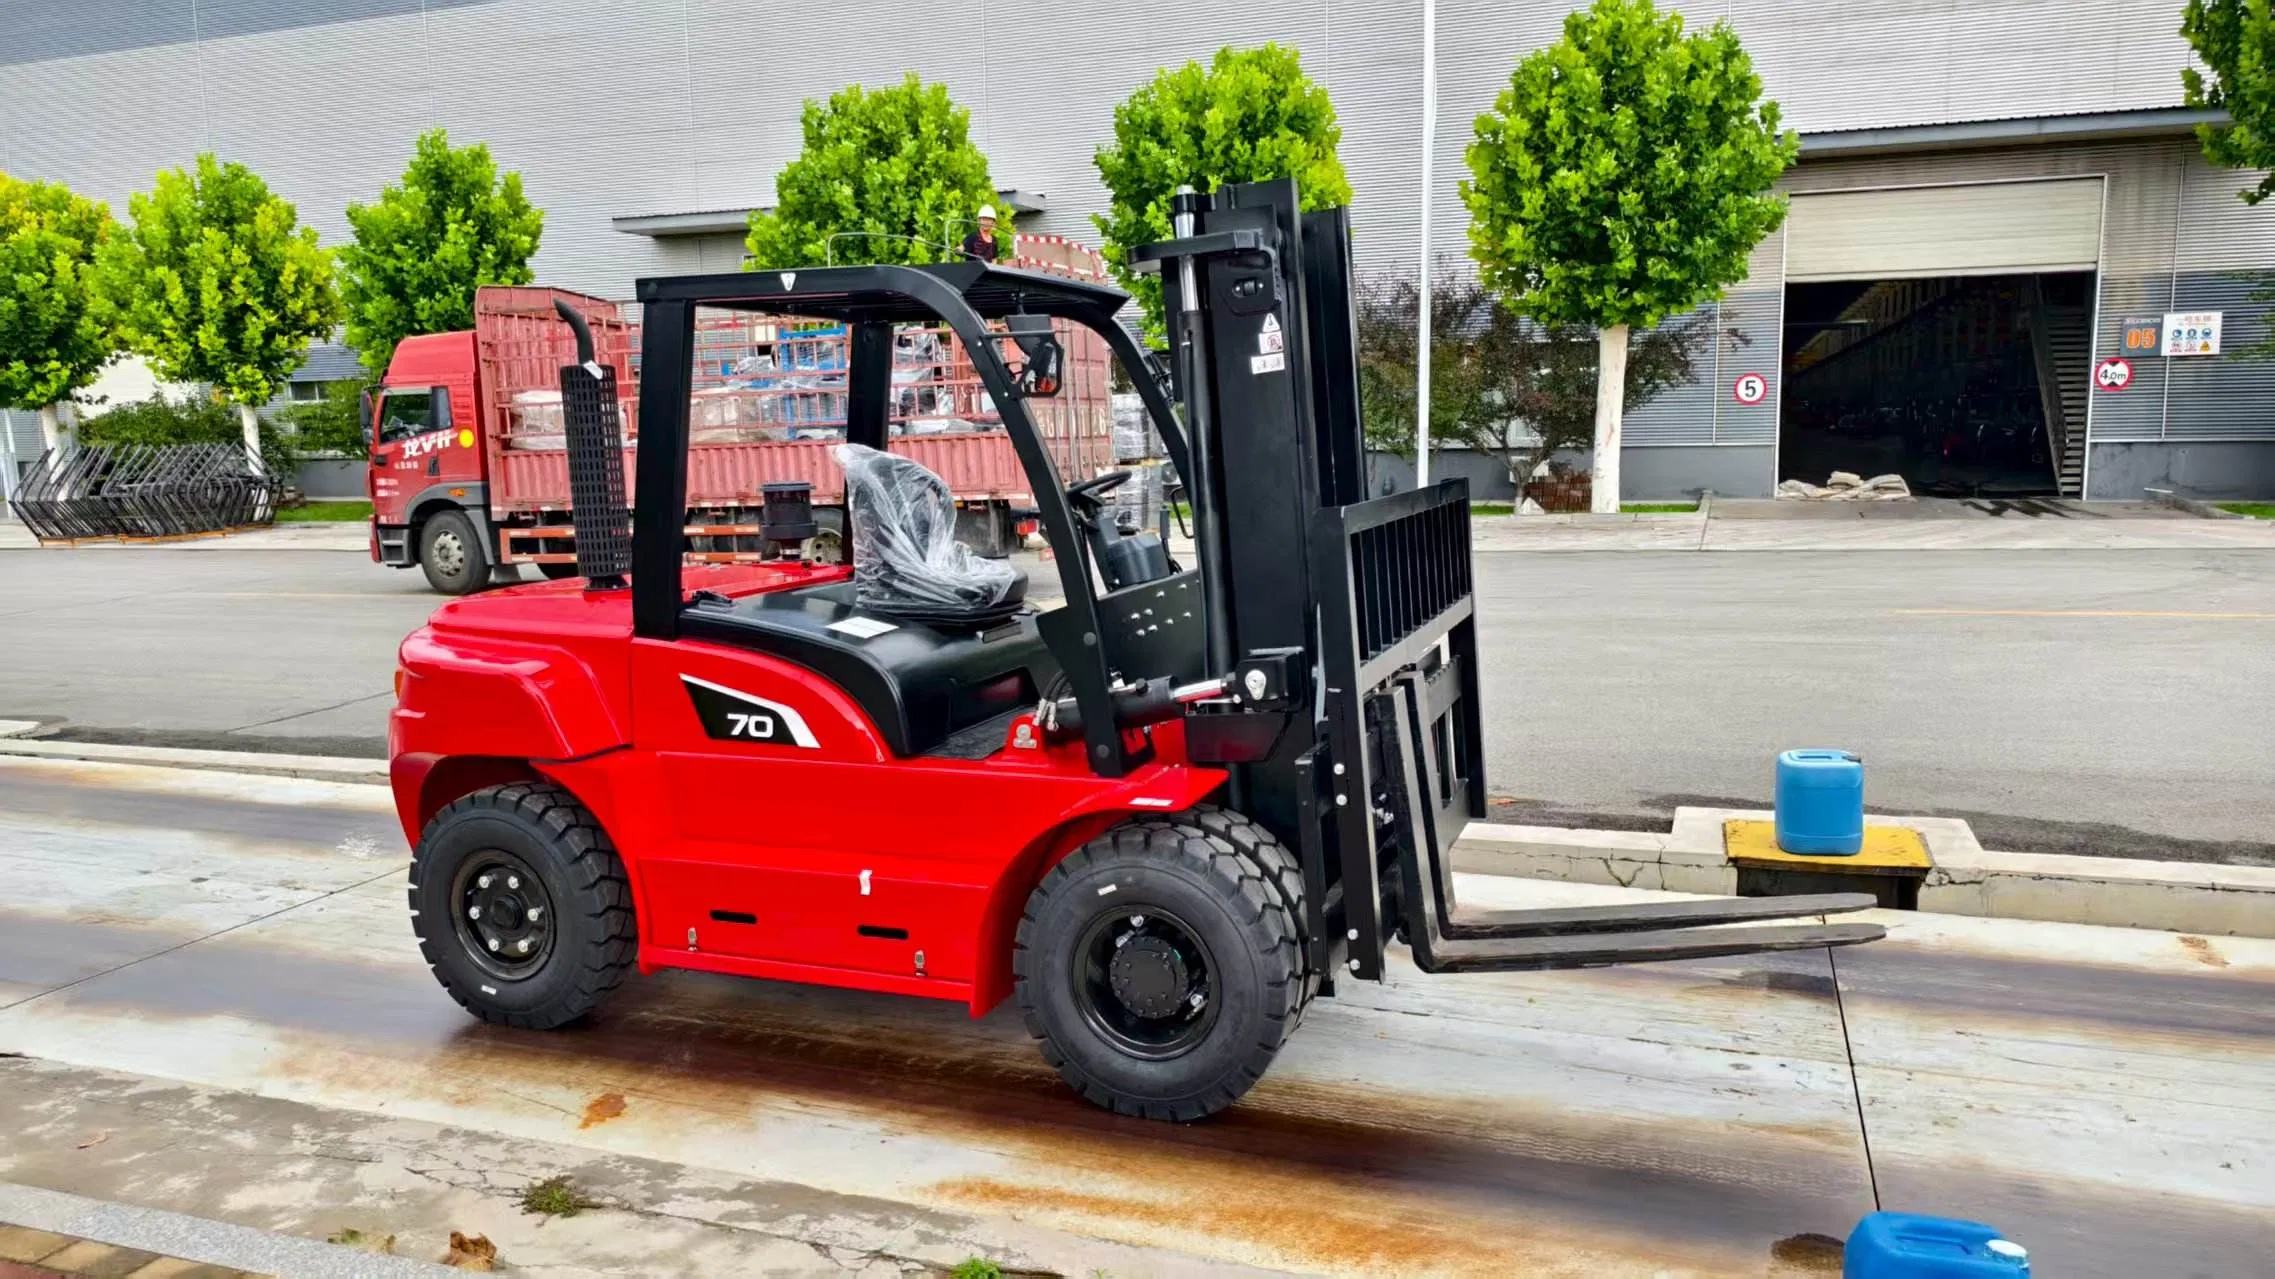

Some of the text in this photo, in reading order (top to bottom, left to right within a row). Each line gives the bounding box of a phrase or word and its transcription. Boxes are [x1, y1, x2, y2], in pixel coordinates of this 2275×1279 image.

[2126, 328, 2156, 349] 05
[2099, 368, 2127, 380] 4.0m
[1745, 379, 1757, 398] 5
[727, 713, 774, 738] 70
